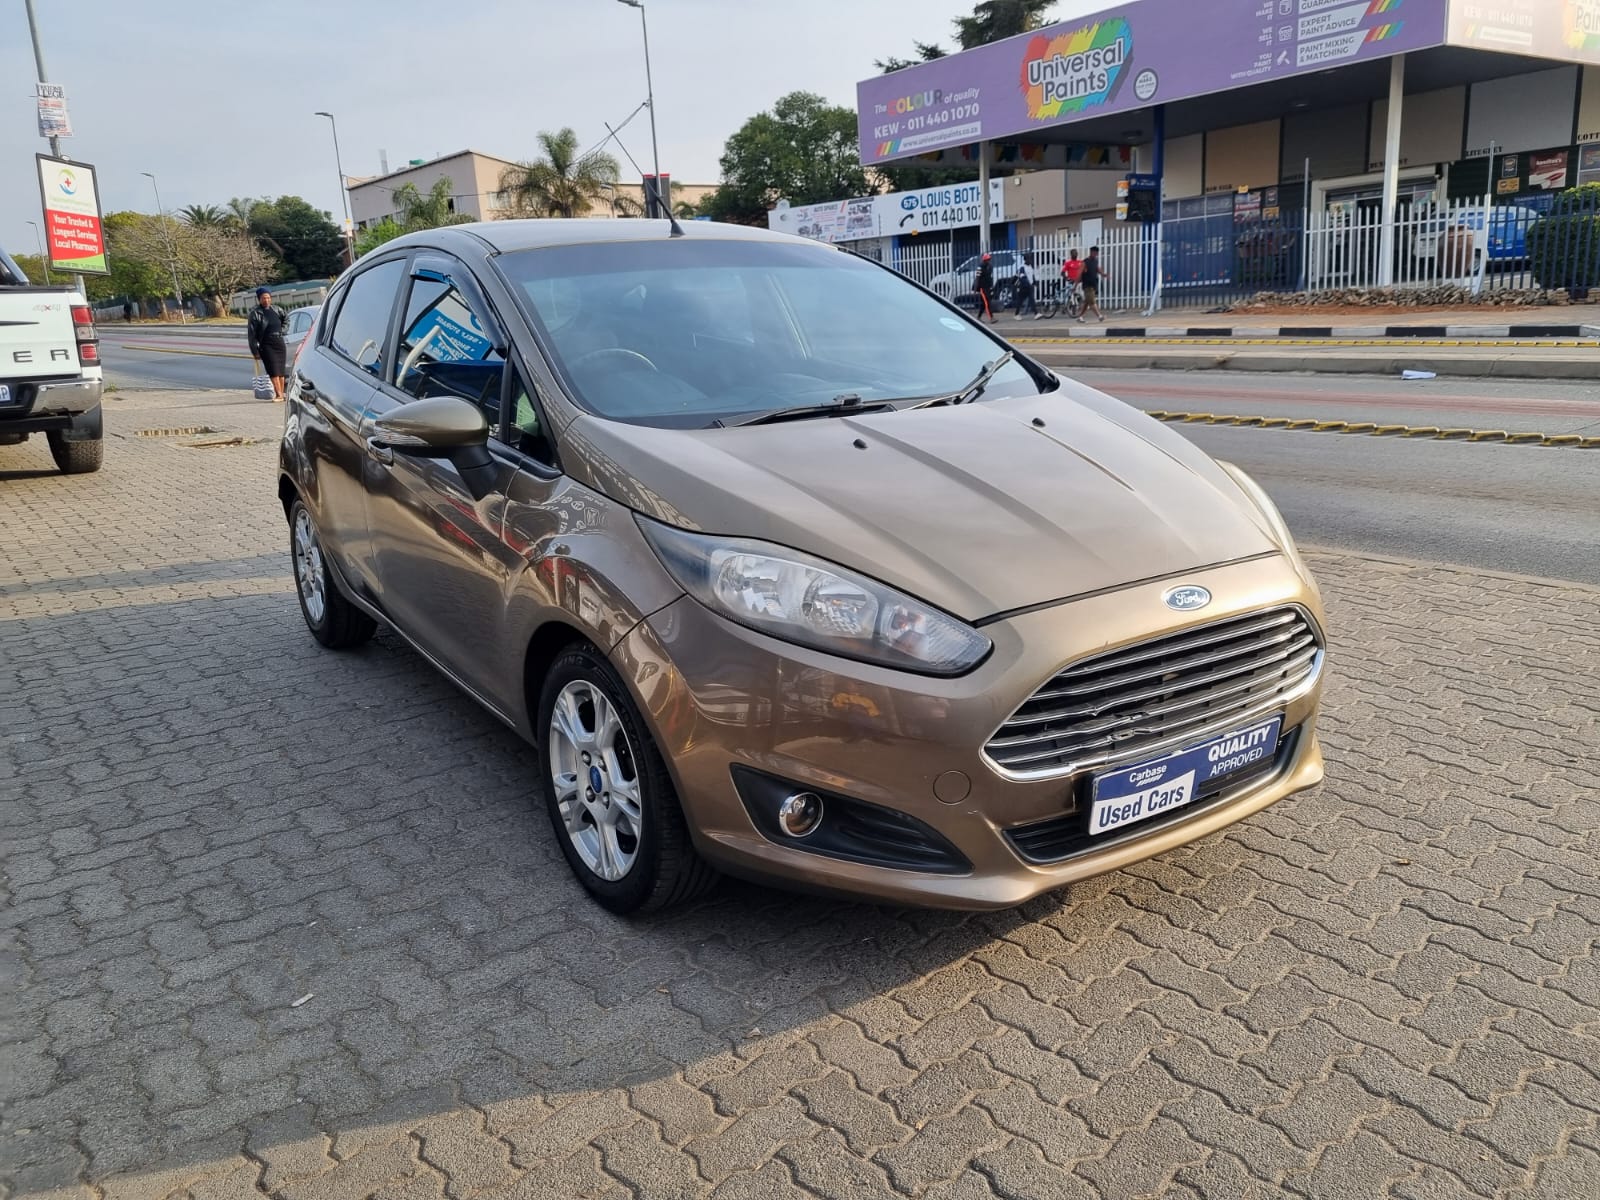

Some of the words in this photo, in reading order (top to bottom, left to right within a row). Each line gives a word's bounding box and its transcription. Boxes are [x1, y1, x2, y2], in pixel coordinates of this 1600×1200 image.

[1301, 14, 1332, 28] EXPERT
[1301, 26, 1324, 36] PAINT
[1325, 17, 1356, 31] ADVICE
[1300, 42, 1324, 54] PAINT
[1325, 36, 1355, 50] MIXING
[1305, 46, 1349, 61] MATCHING
[1029, 40, 1123, 84] Universal
[1044, 69, 1107, 104] Paints
[874, 103, 887, 114] The
[887, 89, 943, 116] COLOUR
[944, 93, 953, 104] of
[953, 87, 980, 102] quality
[874, 122, 899, 139] KEW
[908, 116, 925, 130] 011
[926, 110, 948, 126] 440
[951, 102, 980, 121] 1070
[920, 190, 951, 209] LOUIS
[954, 185, 990, 205] BOTH
[53, 213, 67, 224] Your
[67, 215, 88, 228] Trusted
[88, 219, 94, 229] &
[922, 210, 938, 226] 011
[941, 207, 964, 224] 440
[53, 225, 76, 239] Longest
[76, 229, 98, 243] Serving
[55, 238, 71, 249] Local
[71, 240, 99, 254] Pharmacy
[1175, 590, 1200, 606] Ford
[1207, 725, 1272, 762] QUALITY
[1209, 747, 1263, 777] APPROVED
[1129, 764, 1167, 783] Carbase
[1099, 795, 1143, 828] Used
[1147, 786, 1185, 812] Cars
